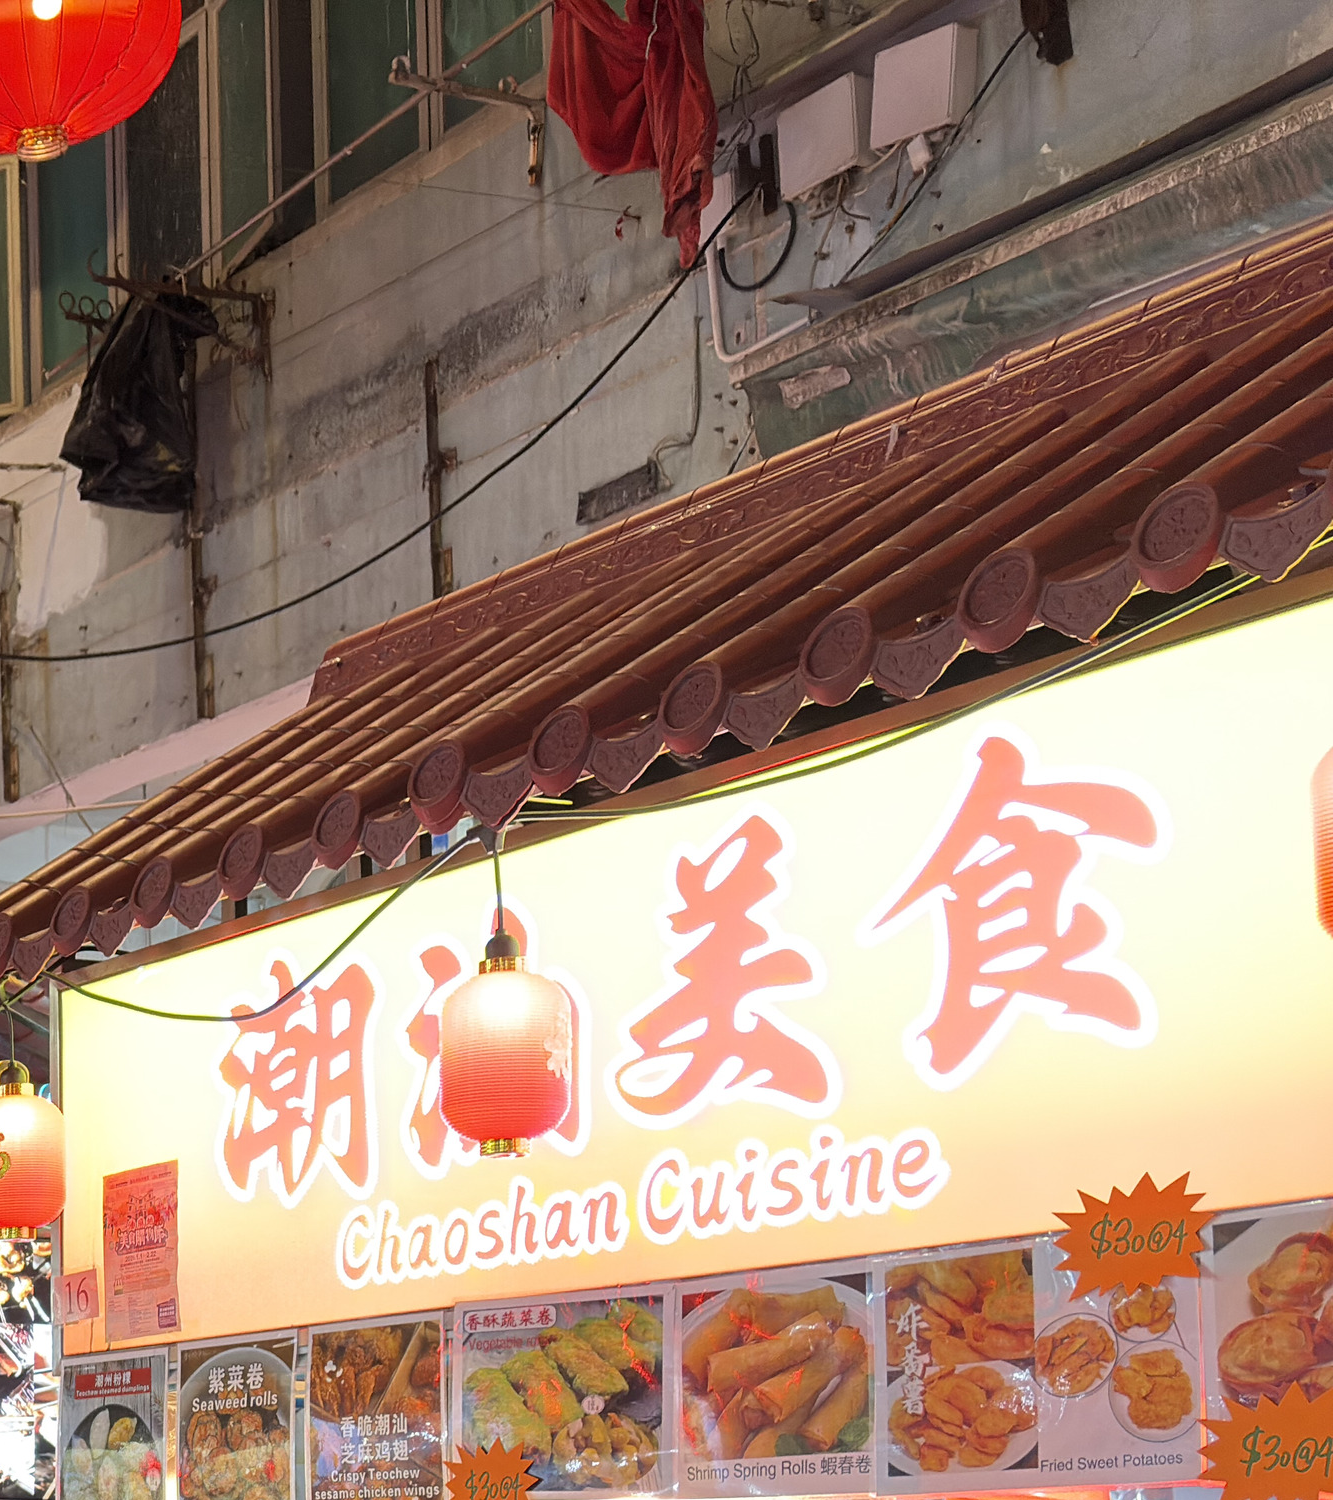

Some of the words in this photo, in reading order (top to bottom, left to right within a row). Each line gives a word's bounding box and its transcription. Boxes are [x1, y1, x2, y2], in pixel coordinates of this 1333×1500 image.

[339, 1184, 620, 1278] Chaoshan
[646, 1134, 936, 1237] Cuisine
[66, 1277, 89, 1315] 16
[465, 1308, 553, 1331] 香酥蔬菜卷
[99, 1386, 121, 1395] steamed
[122, 1384, 150, 1393] dumplings
[208, 1362, 264, 1394] 紫菜卷
[192, 1395, 247, 1412] Seaweed
[250, 1390, 278, 1407] rolls
[340, 1412, 408, 1438] 香脆潮汕
[340, 1439, 409, 1465] 芝麻鸡翅
[1040, 1458, 1073, 1473] Fried
[1077, 1455, 1119, 1471] Sweet
[1122, 1451, 1184, 1468] Potatoes
[331, 1469, 367, 1484] Crispy
[368, 1467, 420, 1481] Teochew
[687, 1461, 729, 1483] Shrimp
[733, 1458, 777, 1480] Spring
[781, 1457, 816, 1475] Rolls
[820, 1453, 871, 1476] 蝦春卷
[314, 1487, 355, 1500] sesame
[357, 1485, 400, 1498] chicken
[404, 1482, 440, 1497] wings
